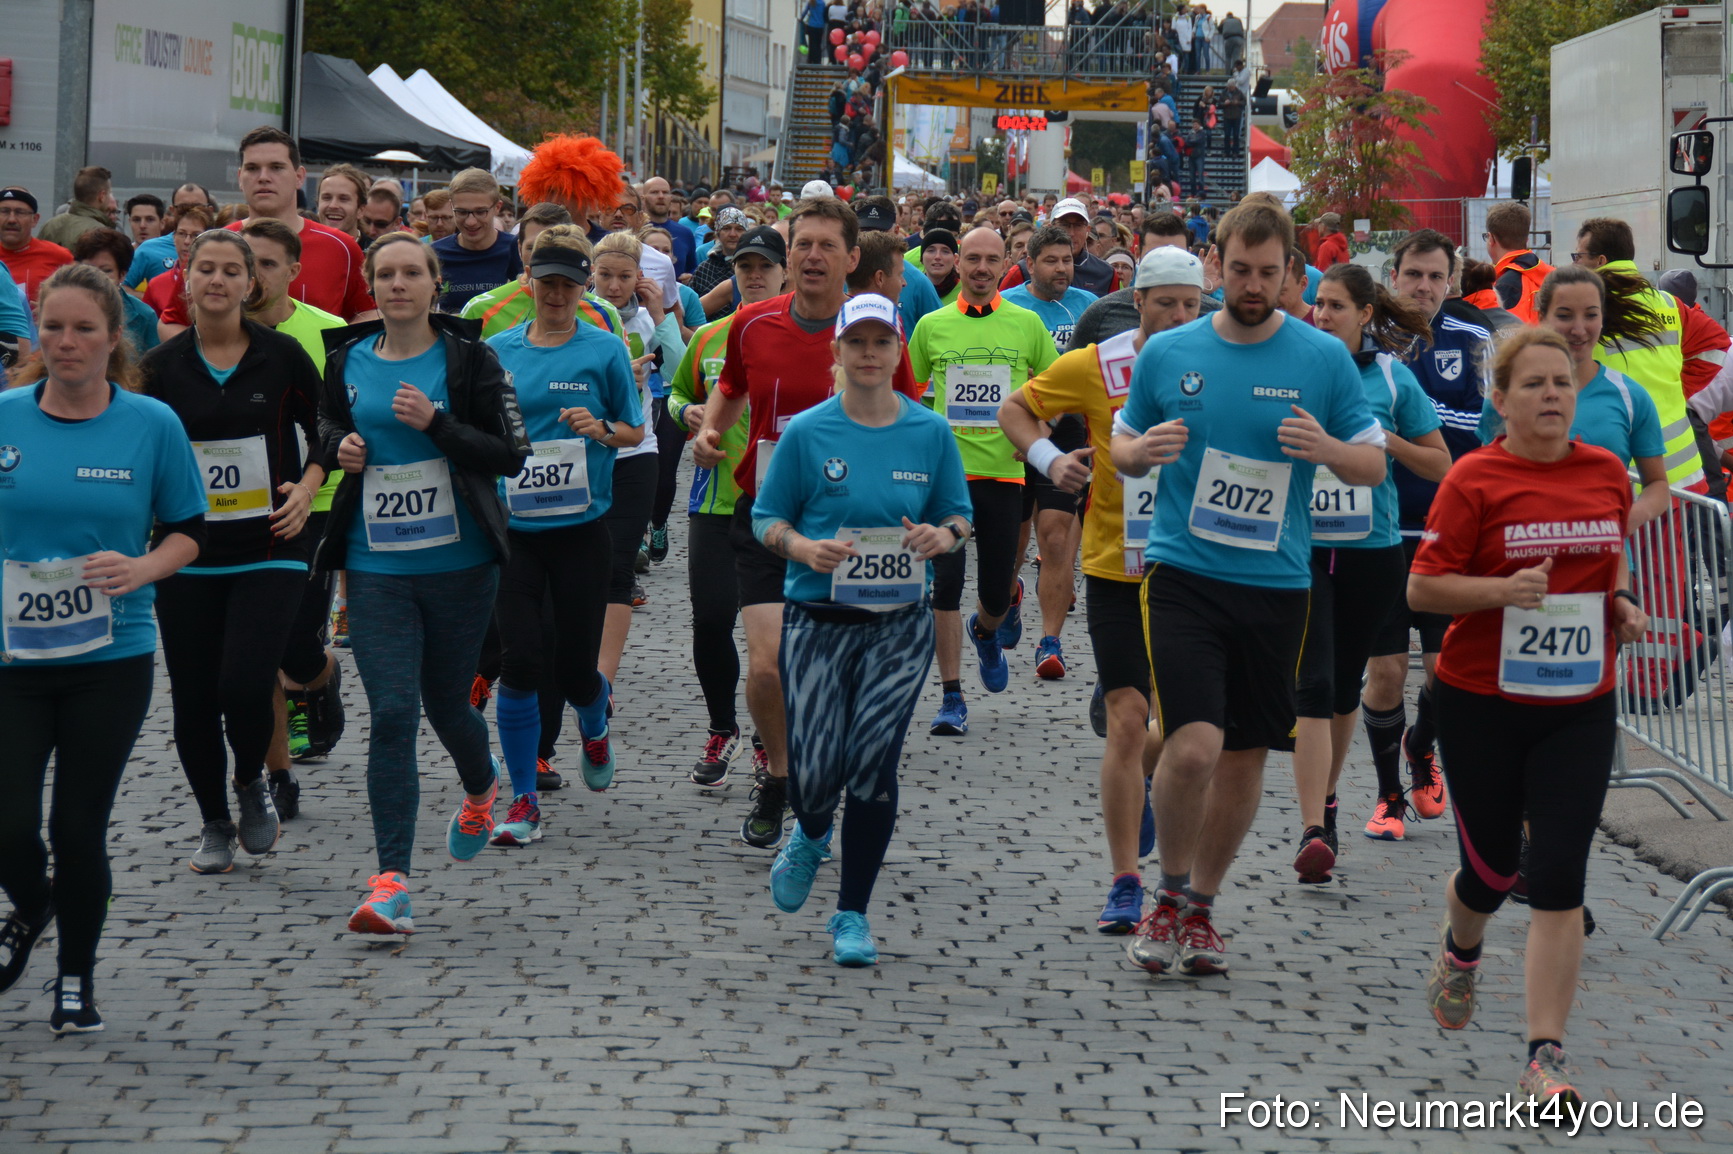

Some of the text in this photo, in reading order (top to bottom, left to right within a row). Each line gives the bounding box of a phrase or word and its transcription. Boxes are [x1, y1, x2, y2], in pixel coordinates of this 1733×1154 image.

[115, 23, 213, 76] OFFICE INDUSTRY LOUNGE
[230, 29, 284, 109] BOCK
[995, 84, 1051, 105] ZIEL
[20, 141, 42, 151] 1106
[984, 179, 994, 191] A
[450, 284, 474, 292] GOSSEN
[851, 302, 889, 313] ERDINGER
[1441, 358, 1449, 369] F
[1450, 365, 1458, 375] C
[549, 381, 589, 391] BOCK
[1253, 386, 1300, 399] BOCK
[954, 383, 1002, 403] 2528
[964, 408, 991, 417] Thomas
[76, 467, 132, 480] BOCK
[208, 465, 240, 489] 20
[518, 462, 574, 489] 2587
[892, 470, 930, 483] BOCK
[216, 498, 238, 507] Aline
[375, 487, 438, 518] 2207
[534, 494, 563, 504] Verena
[1208, 479, 1274, 516] 2072
[395, 523, 426, 537] Carina
[1213, 516, 1258, 534] Johannes
[1315, 519, 1346, 529] Kerstin
[1505, 546, 1559, 559] HAUSHALT
[1568, 544, 1601, 555] KÜCHE
[847, 553, 912, 580] 2588
[857, 587, 900, 599] Michaela
[18, 585, 93, 622] 2930
[1518, 625, 1592, 657] 2470
[1536, 666, 1574, 679] Christa
